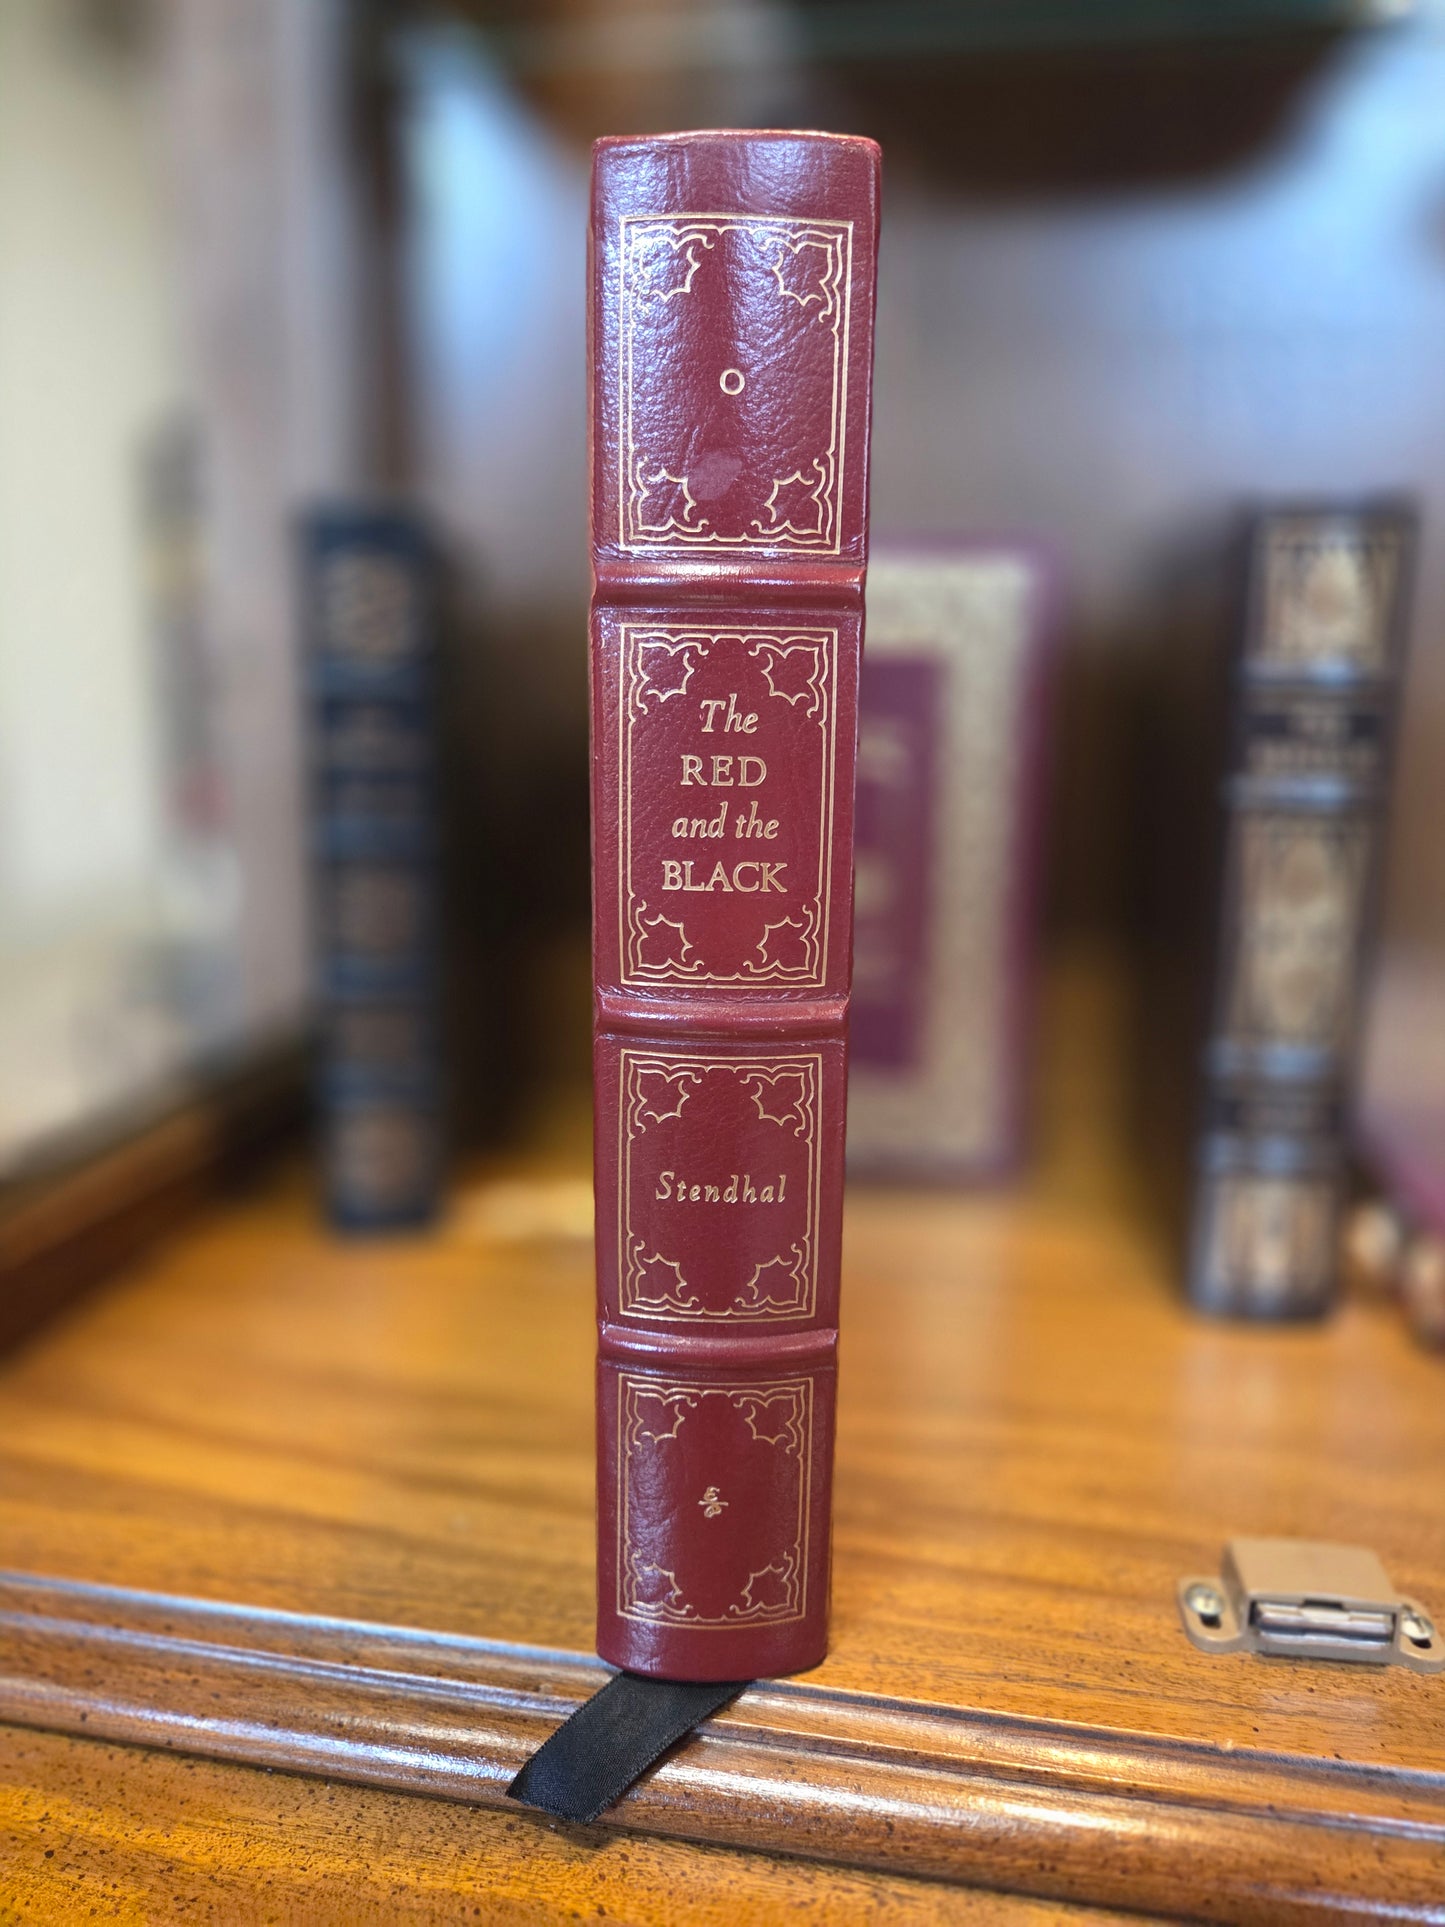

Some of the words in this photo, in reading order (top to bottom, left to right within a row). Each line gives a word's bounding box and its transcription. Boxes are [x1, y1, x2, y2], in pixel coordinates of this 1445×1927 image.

[700, 693, 758, 734] The
[679, 755, 768, 786] RED
[671, 801, 729, 839] and
[735, 801, 780, 839] the
[661, 860, 788, 893] BLACK
[655, 1170, 787, 1203] Stendhal
